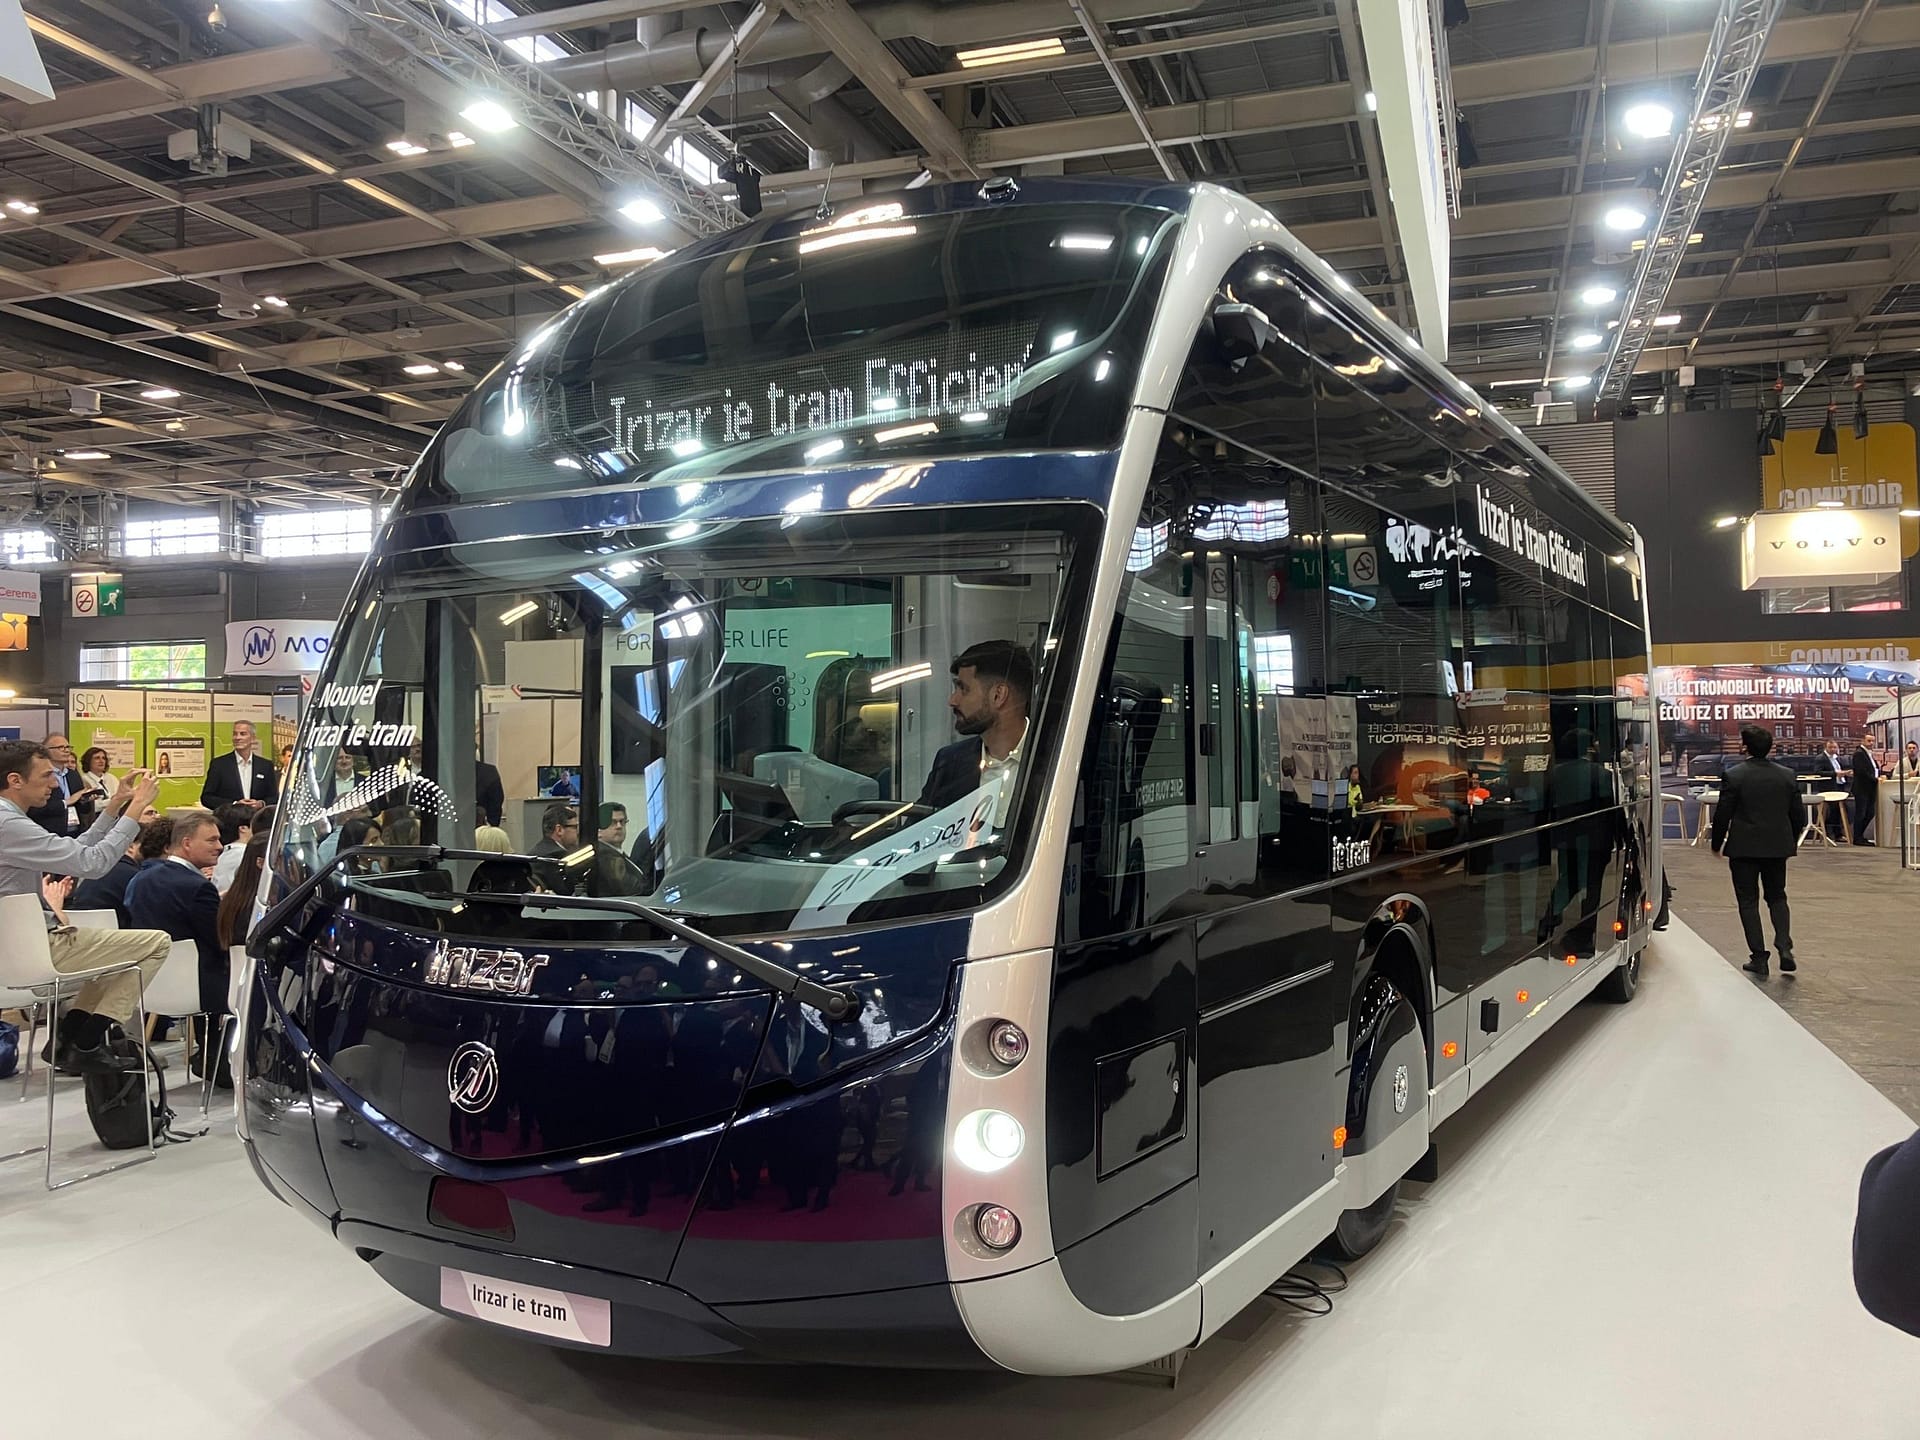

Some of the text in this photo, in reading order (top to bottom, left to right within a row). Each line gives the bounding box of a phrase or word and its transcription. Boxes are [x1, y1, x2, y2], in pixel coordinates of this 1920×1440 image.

[611, 397, 712, 455] Irizar
[723, 388, 753, 442] ie
[768, 382, 853, 435] tram
[1831, 466, 1849, 482] LE
[1476, 484, 1510, 548] Irizar
[1510, 503, 1524, 555] ie
[1523, 518, 1549, 569] tram
[1548, 529, 1586, 587] Efficient
[1770, 536, 1886, 550] VOLVO
[616, 633, 651, 651] FOR
[751, 628, 789, 648] LIFE
[1770, 641, 1788, 657] LE
[318, 678, 383, 708] Nouvel
[1777, 678, 1804, 694] PAR
[1807, 677, 1854, 694] VOLVO,
[72, 693, 109, 712] ISRA
[1660, 702, 1796, 721] ÉCOUTEZ ET RESPIREZ.
[305, 718, 417, 748] Irizar ie tram
[425, 939, 550, 995] Irizar
[473, 1283, 567, 1322] Irizar ie tram
